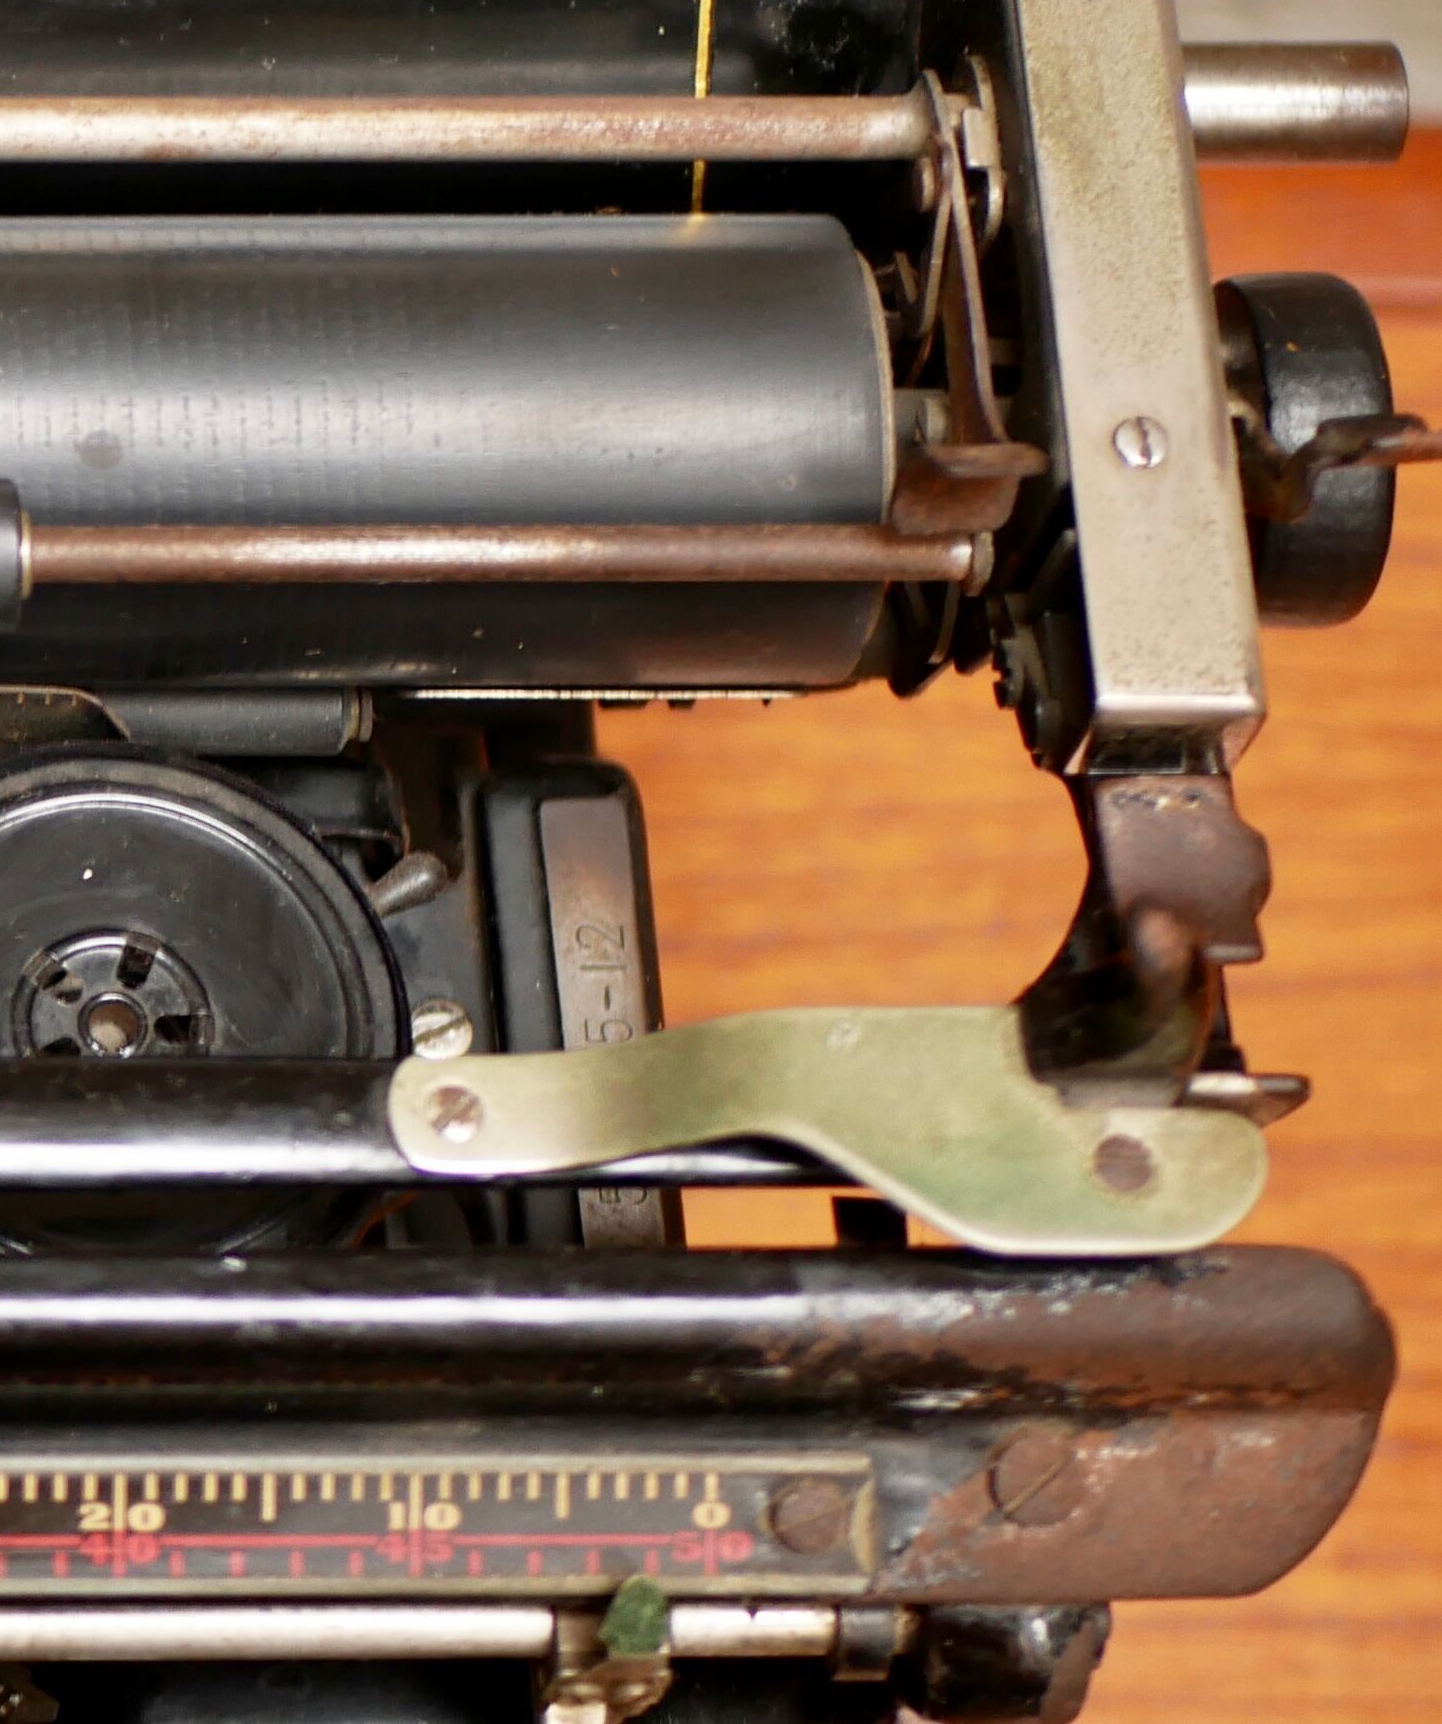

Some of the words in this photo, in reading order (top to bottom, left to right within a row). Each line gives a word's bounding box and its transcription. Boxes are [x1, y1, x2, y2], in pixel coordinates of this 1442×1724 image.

[77, 1502, 166, 1532] 20
[387, 1501, 462, 1531] 10
[692, 1502, 732, 1530] 0
[78, 1532, 162, 1566] 40
[375, 1530, 456, 1564] 45
[670, 1530, 755, 1563] 50
